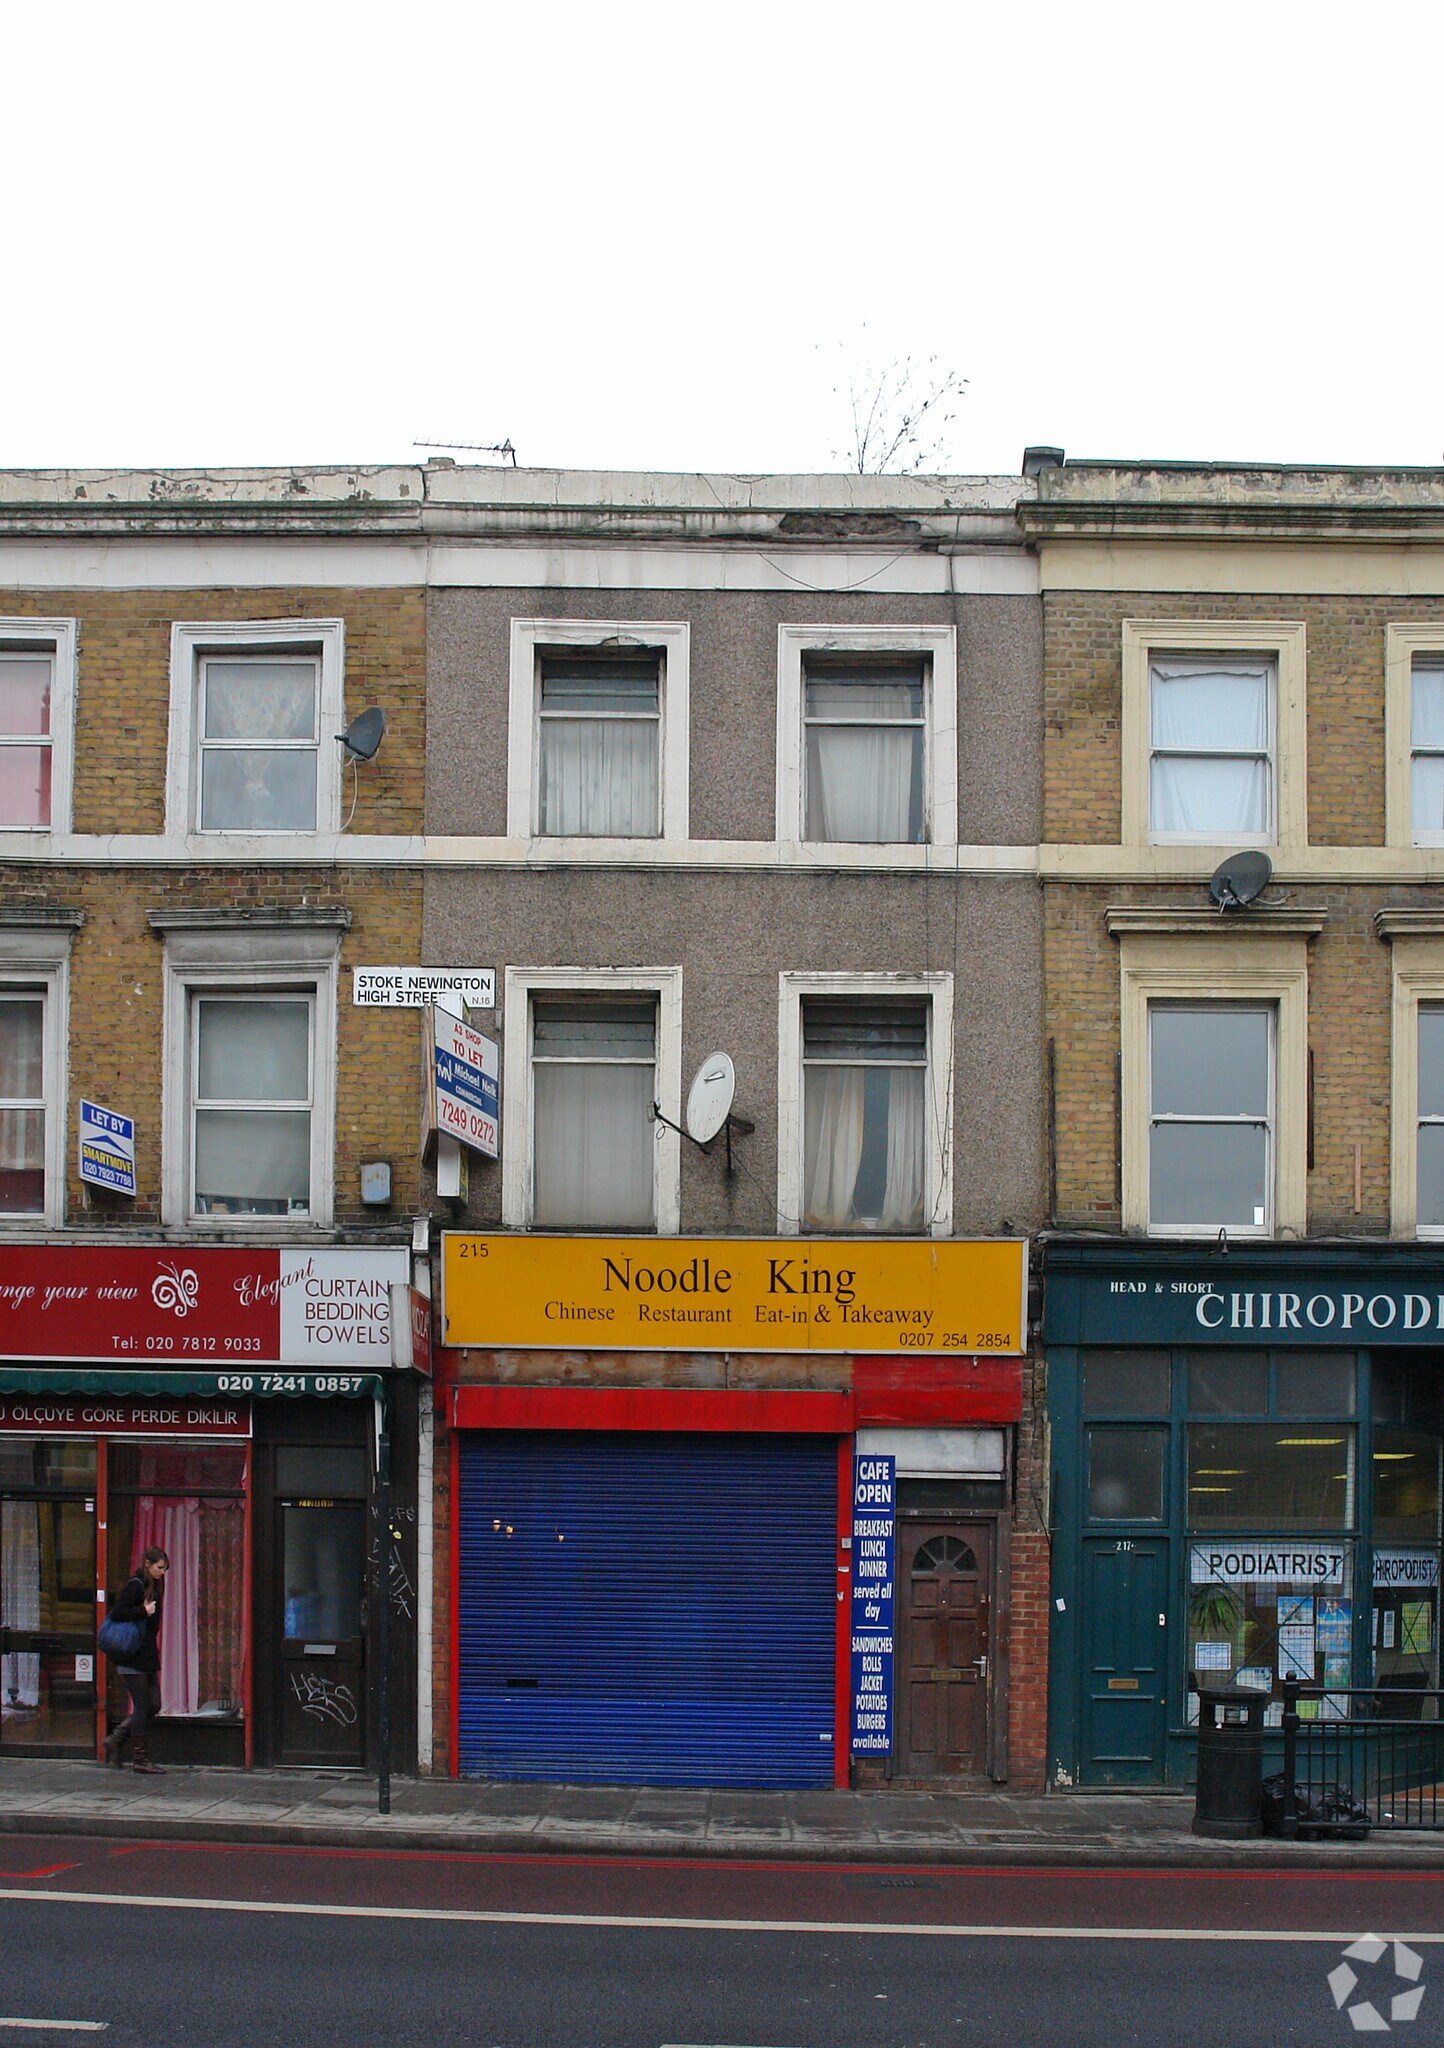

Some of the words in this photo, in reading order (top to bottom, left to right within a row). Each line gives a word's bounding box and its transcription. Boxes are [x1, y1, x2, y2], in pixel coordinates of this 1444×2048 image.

[358, 975, 403, 989] STOKE
[408, 976, 491, 990] NEWINGTON
[358, 990, 390, 1003] HIGH
[454, 1023, 463, 1036] A3
[465, 1029, 481, 1046] SHOP
[453, 1039, 464, 1058] TO
[468, 1047, 483, 1068] LET
[454, 1063, 480, 1089] Michael
[91, 1109, 109, 1128] LET
[111, 1117, 125, 1134] BY
[441, 1098, 467, 1130] 7249
[470, 1115, 494, 1145] 0272
[83, 1145, 133, 1174] SMARTMOVE
[459, 1243, 489, 1258] 215
[233, 1256, 315, 1307] Elegant
[305, 1279, 390, 1297] CURTAIN
[602, 1258, 732, 1293] Noodle
[766, 1258, 856, 1304] King
[1110, 1282, 1147, 1293] HEAD
[1154, 1282, 1164, 1294] &
[1171, 1282, 1214, 1294] SHORT
[41, 1286, 88, 1310] your
[95, 1279, 139, 1300] view
[305, 1302, 390, 1321] BEDDING
[545, 1302, 615, 1321] Chinese
[638, 1304, 732, 1323] Restaurant
[755, 1305, 807, 1323] Eat-in
[814, 1304, 832, 1323] &
[838, 1304, 934, 1329] Takeaway
[112, 1335, 138, 1350] Tel:
[145, 1336, 174, 1351] 020
[182, 1337, 216, 1351] 7812
[224, 1337, 261, 1352] 9033
[304, 1325, 390, 1345] TOWELS
[899, 1332, 934, 1346] 0207
[942, 1333, 968, 1347] 254
[977, 1333, 1011, 1347] 2854
[217, 1375, 253, 1391] 020
[261, 1376, 306, 1391] 7241
[315, 1377, 363, 1392] 0857
[12, 1405, 75, 1424] ÖLÇÜYE
[82, 1405, 125, 1423] GÖRE
[132, 1410, 180, 1424] PERDE
[187, 1408, 238, 1425] DİKİLİR
[859, 1462, 889, 1481] CAFE
[857, 1485, 892, 1503] OPEN
[854, 1520, 893, 1537] BREAKFAST
[860, 1541, 886, 1557] LUNCH
[859, 1561, 887, 1577] DINNER
[1209, 1554, 1342, 1577] PODIATRIST
[1373, 1558, 1434, 1581] HROPODIST
[853, 1582, 880, 1599] served
[880, 1582, 892, 1599] all
[865, 1601, 880, 1622] day
[852, 1637, 893, 1654] SANDWICHES
[862, 1656, 882, 1672] ROLLS
[860, 1675, 883, 1692] JACKET
[856, 1695, 887, 1711] POTATOES
[857, 1714, 886, 1730] BURGERS
[852, 1733, 890, 1749] available
